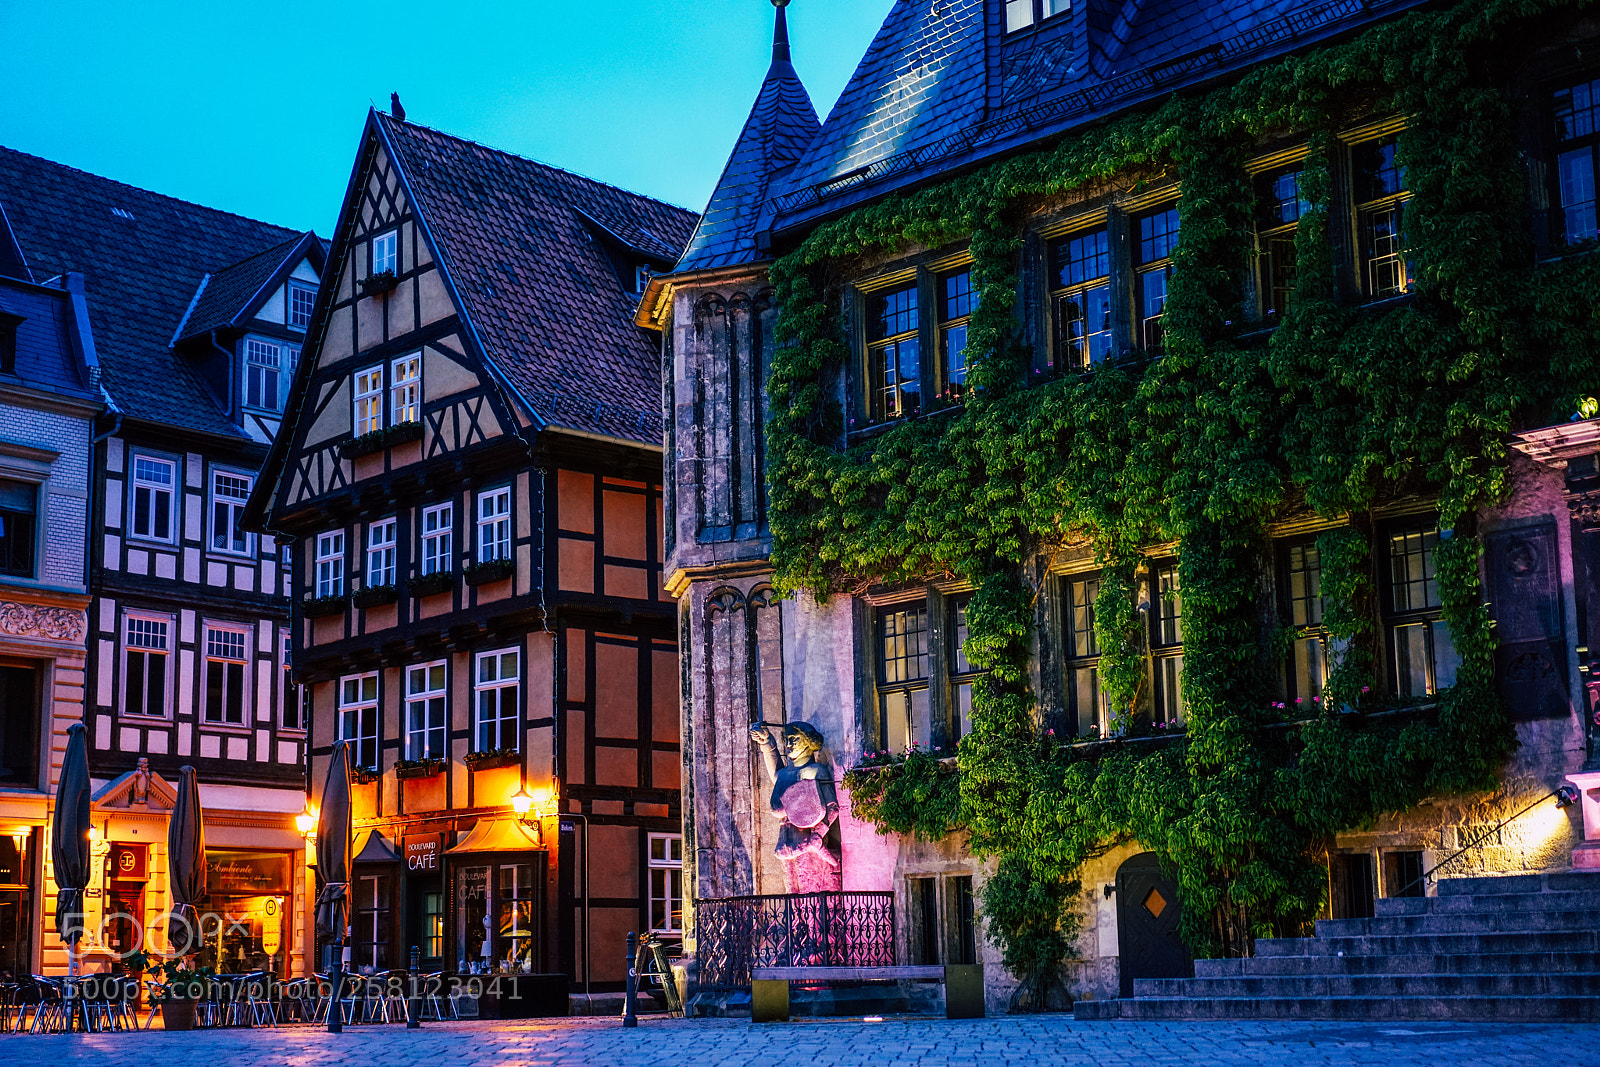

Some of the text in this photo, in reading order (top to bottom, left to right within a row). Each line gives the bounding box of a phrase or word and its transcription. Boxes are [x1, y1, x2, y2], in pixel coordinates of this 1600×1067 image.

[408, 841, 436, 853] BOULEVARD
[206, 859, 253, 873] Ambiente
[408, 850, 436, 871] CAFÉ
